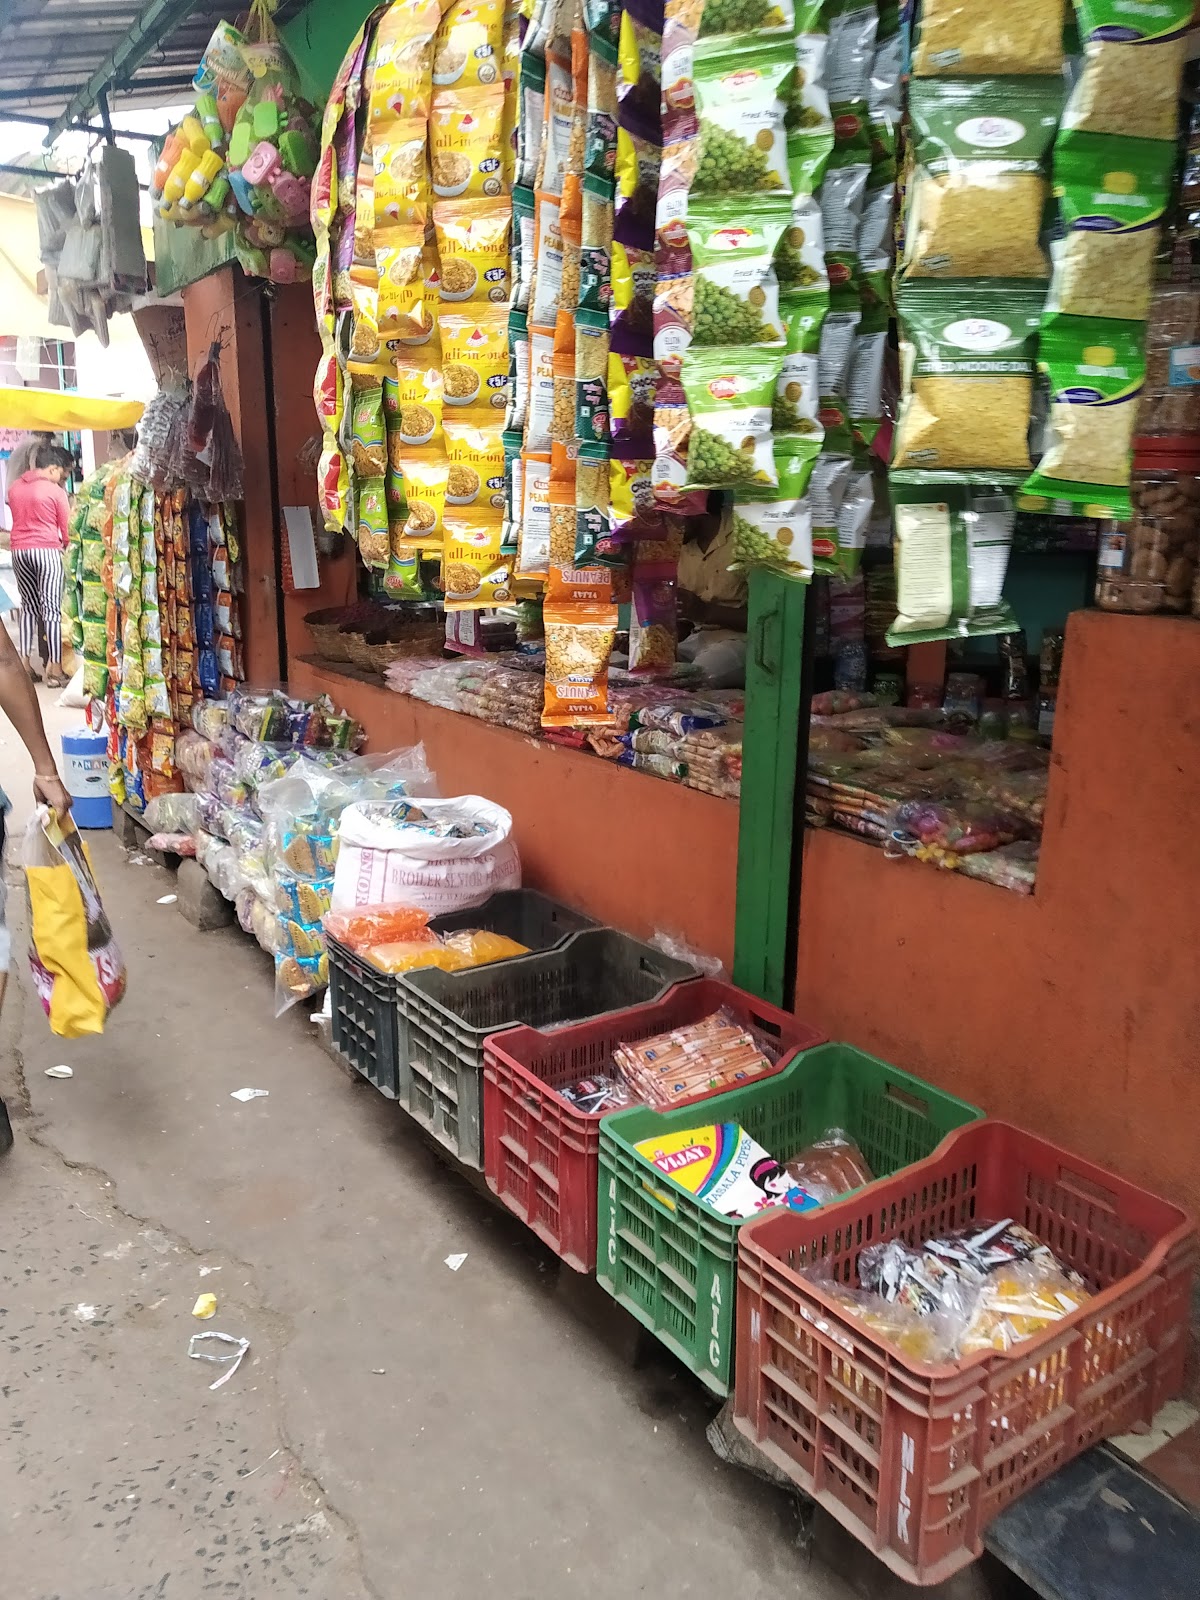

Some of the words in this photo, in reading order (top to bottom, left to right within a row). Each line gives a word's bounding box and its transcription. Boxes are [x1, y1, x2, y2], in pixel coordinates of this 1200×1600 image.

[561, 570, 611, 584] PEANUTS
[571, 590, 598, 599] VIJAY
[603, 635, 609, 644] 5
[567, 703, 594, 712] VIJAY
[391, 868, 441, 887] BROILER
[444, 873, 483, 888] SENIOR
[656, 1145, 705, 1172] VIJAY
[736, 1138, 752, 1167] PIPES
